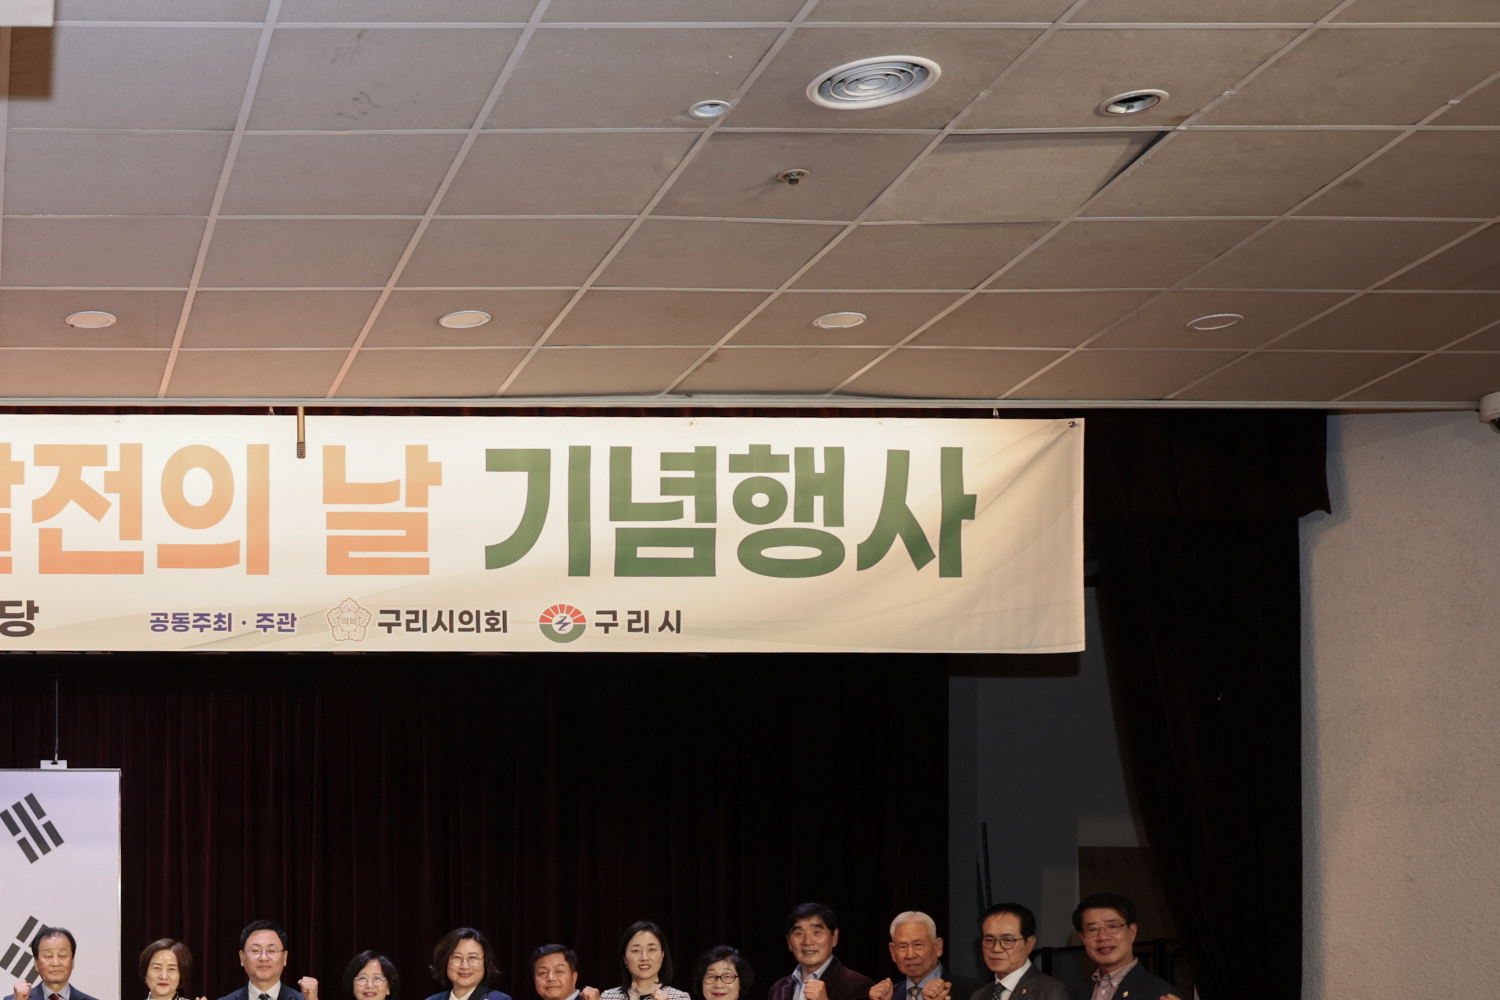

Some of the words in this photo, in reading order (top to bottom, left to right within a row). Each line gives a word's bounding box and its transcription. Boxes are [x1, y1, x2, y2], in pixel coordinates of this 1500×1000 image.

[322, 443, 443, 576] 날
[484, 444, 978, 579] 기념행사
[150, 612, 233, 633] 공동주최
[255, 612, 297, 633] 주관
[341, 616, 357, 626] 의회
[378, 609, 508, 634] 구리시의회
